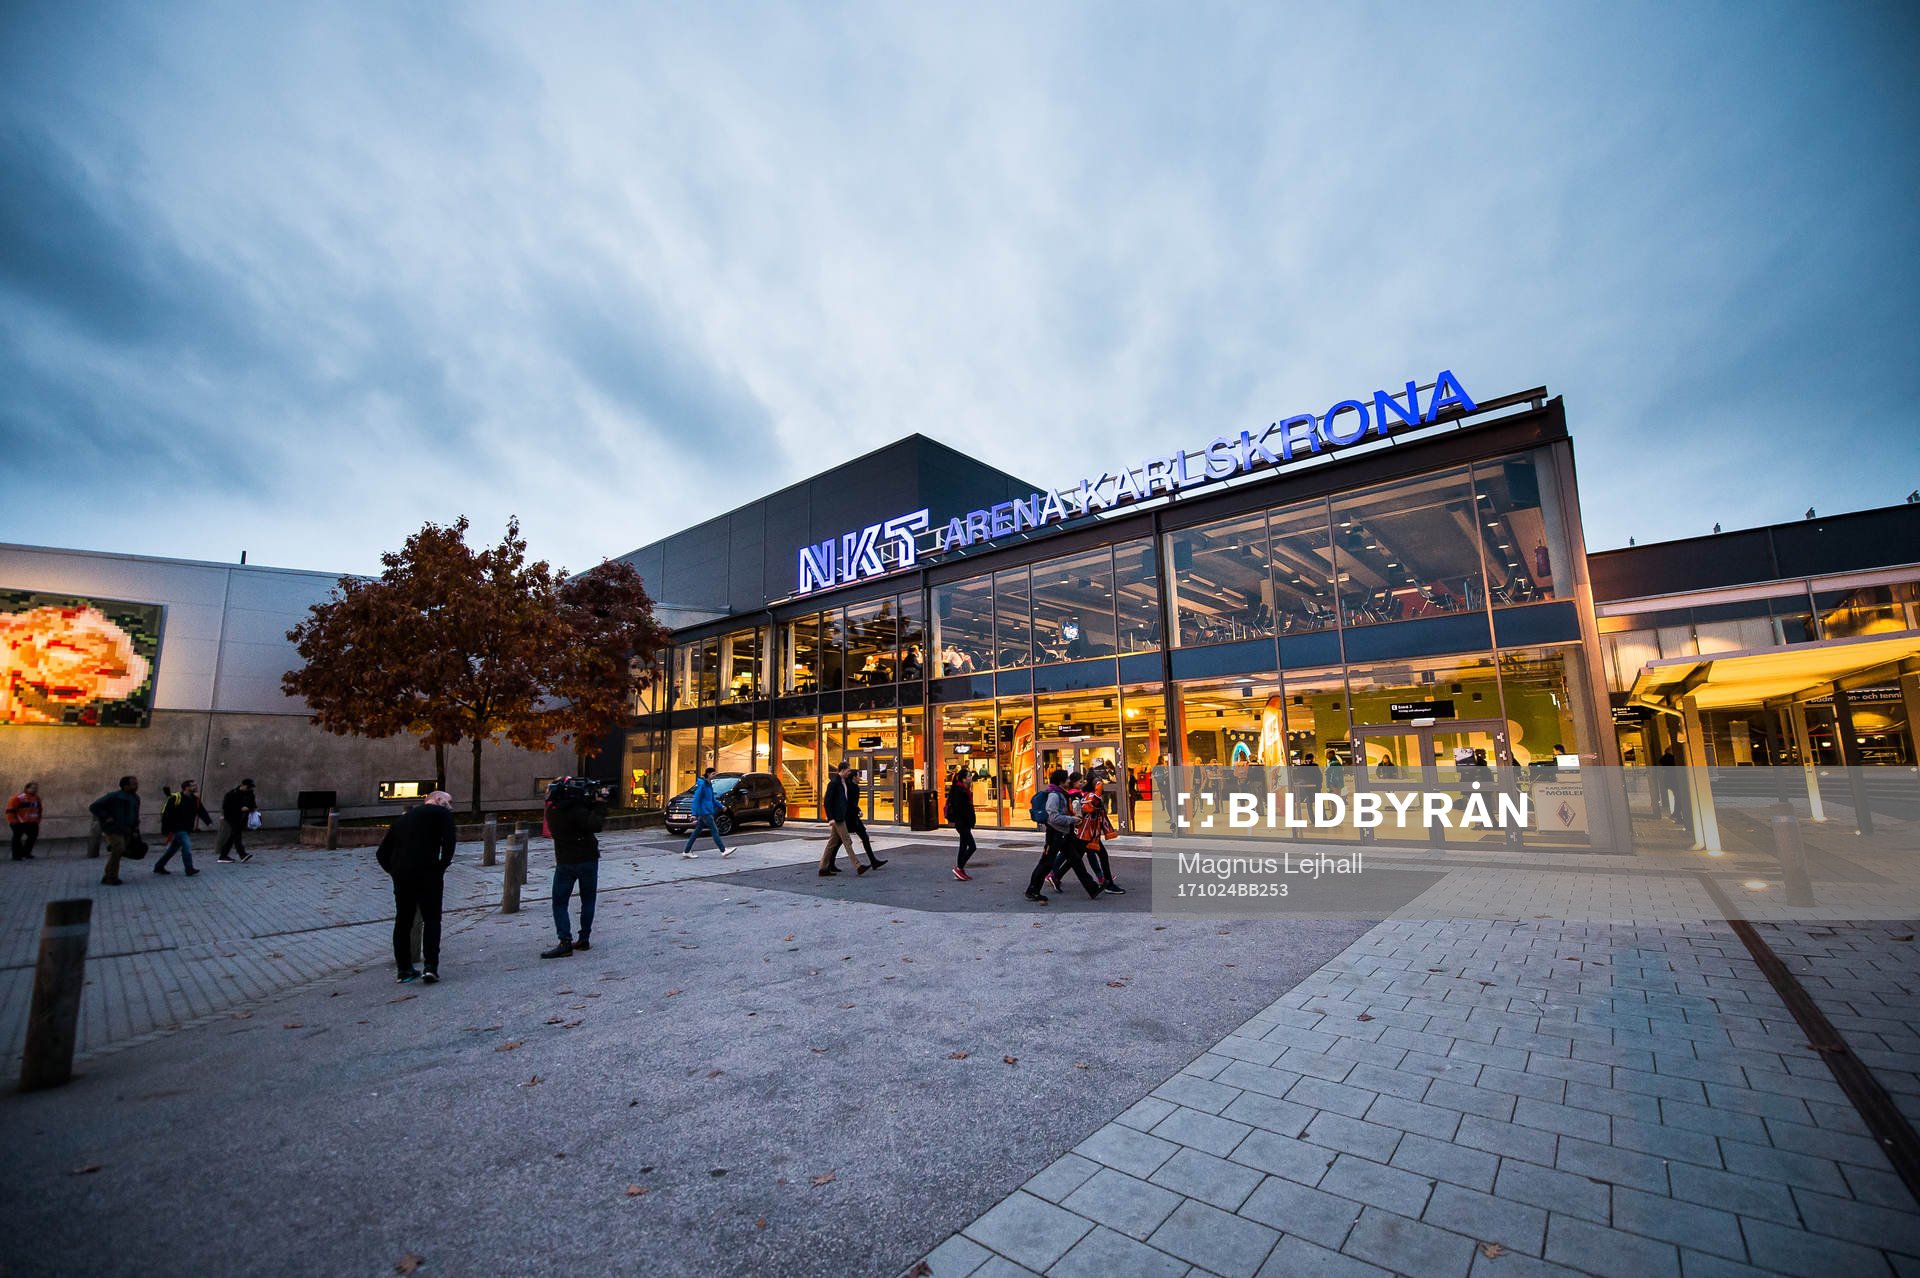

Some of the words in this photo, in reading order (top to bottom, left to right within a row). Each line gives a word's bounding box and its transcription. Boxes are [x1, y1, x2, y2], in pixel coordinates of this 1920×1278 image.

[799, 508, 929, 594] NKT
[944, 487, 1068, 551] ARENA
[1079, 369, 1477, 515] KARLSKRONA
[1862, 692, 1878, 700] och
[1880, 690, 1902, 699] tenni
